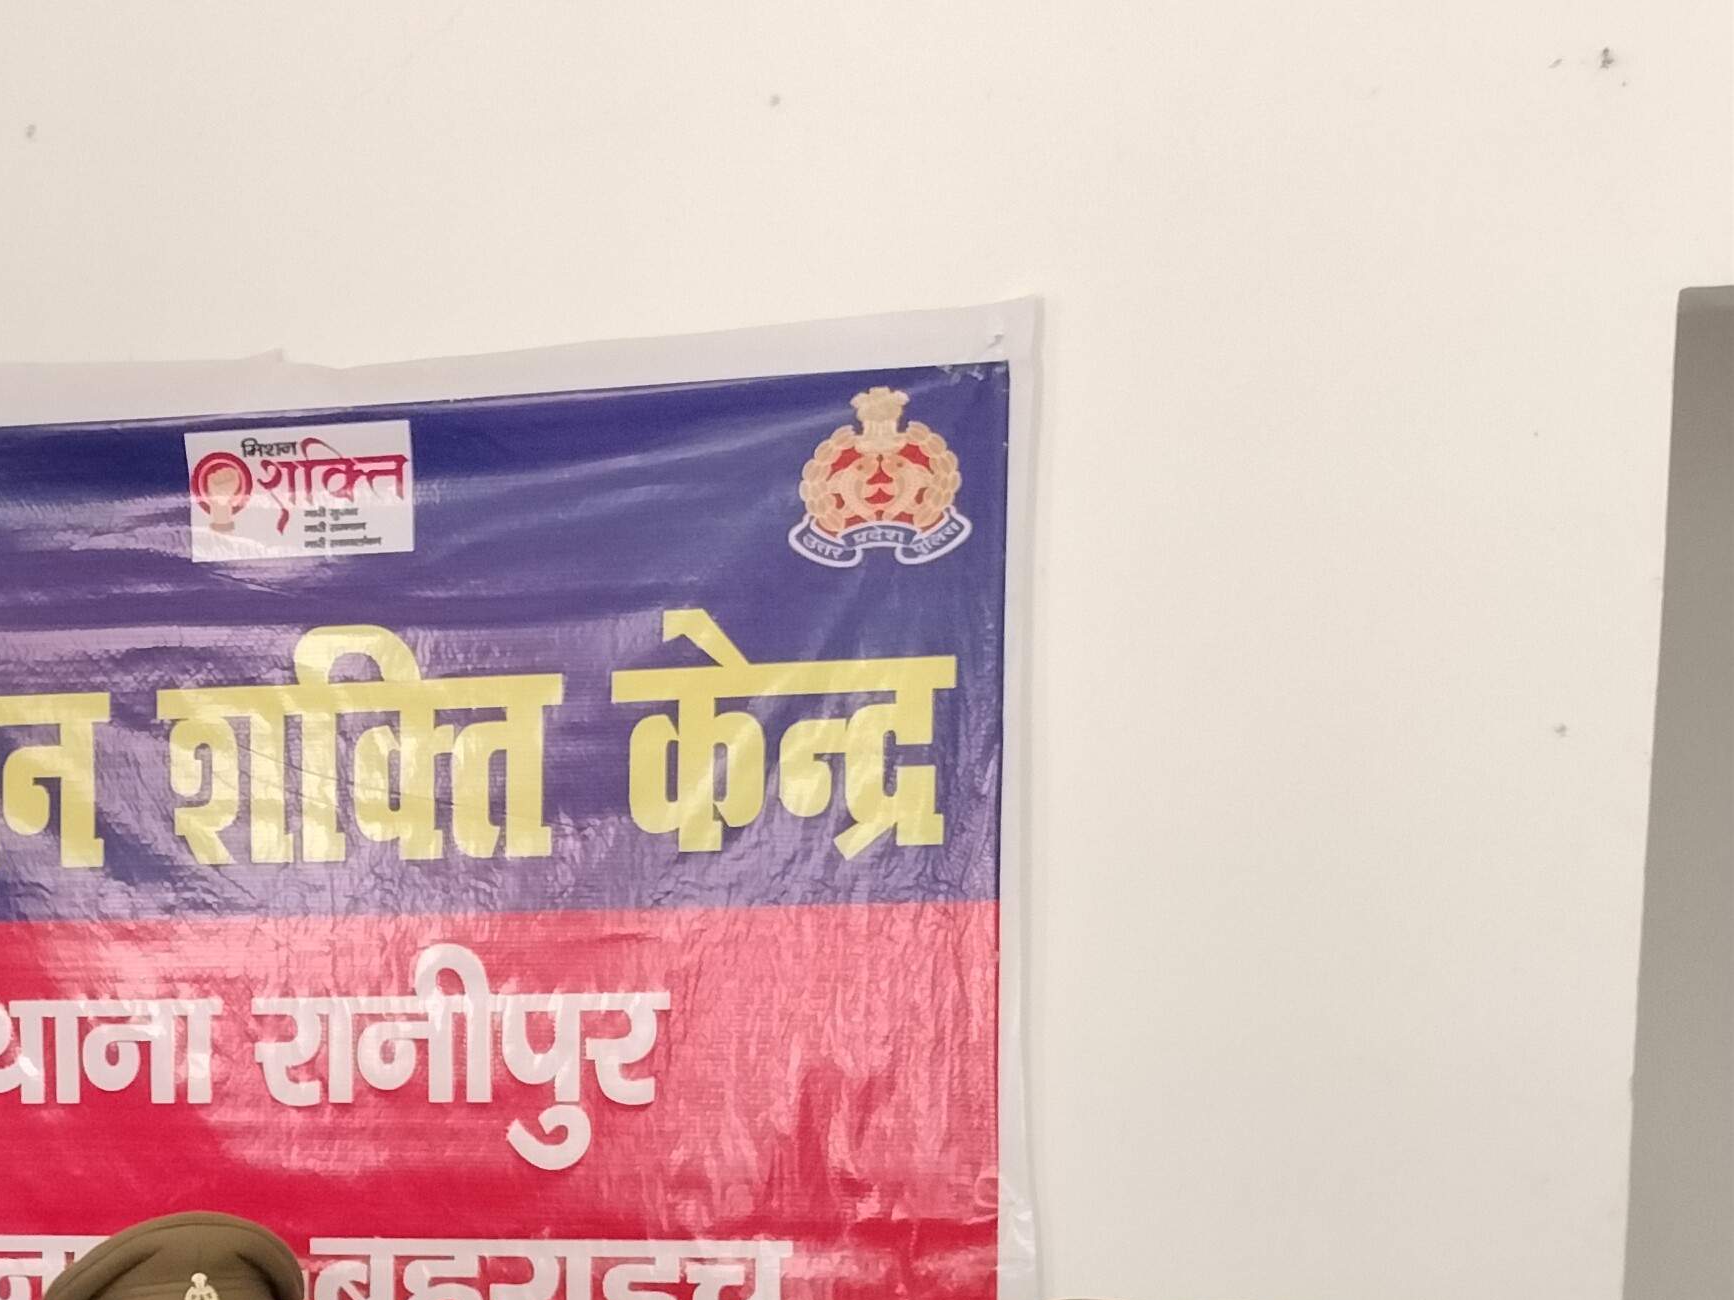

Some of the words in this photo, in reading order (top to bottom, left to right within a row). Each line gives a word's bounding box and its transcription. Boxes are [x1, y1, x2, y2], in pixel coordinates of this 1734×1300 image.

[241, 438, 297, 457] मिशन
[257, 437, 408, 534] शक्ति
[156, 625, 563, 863] शक्ति
[611, 608, 956, 861] केन्द्र
[252, 943, 669, 1170] रानीपुर
